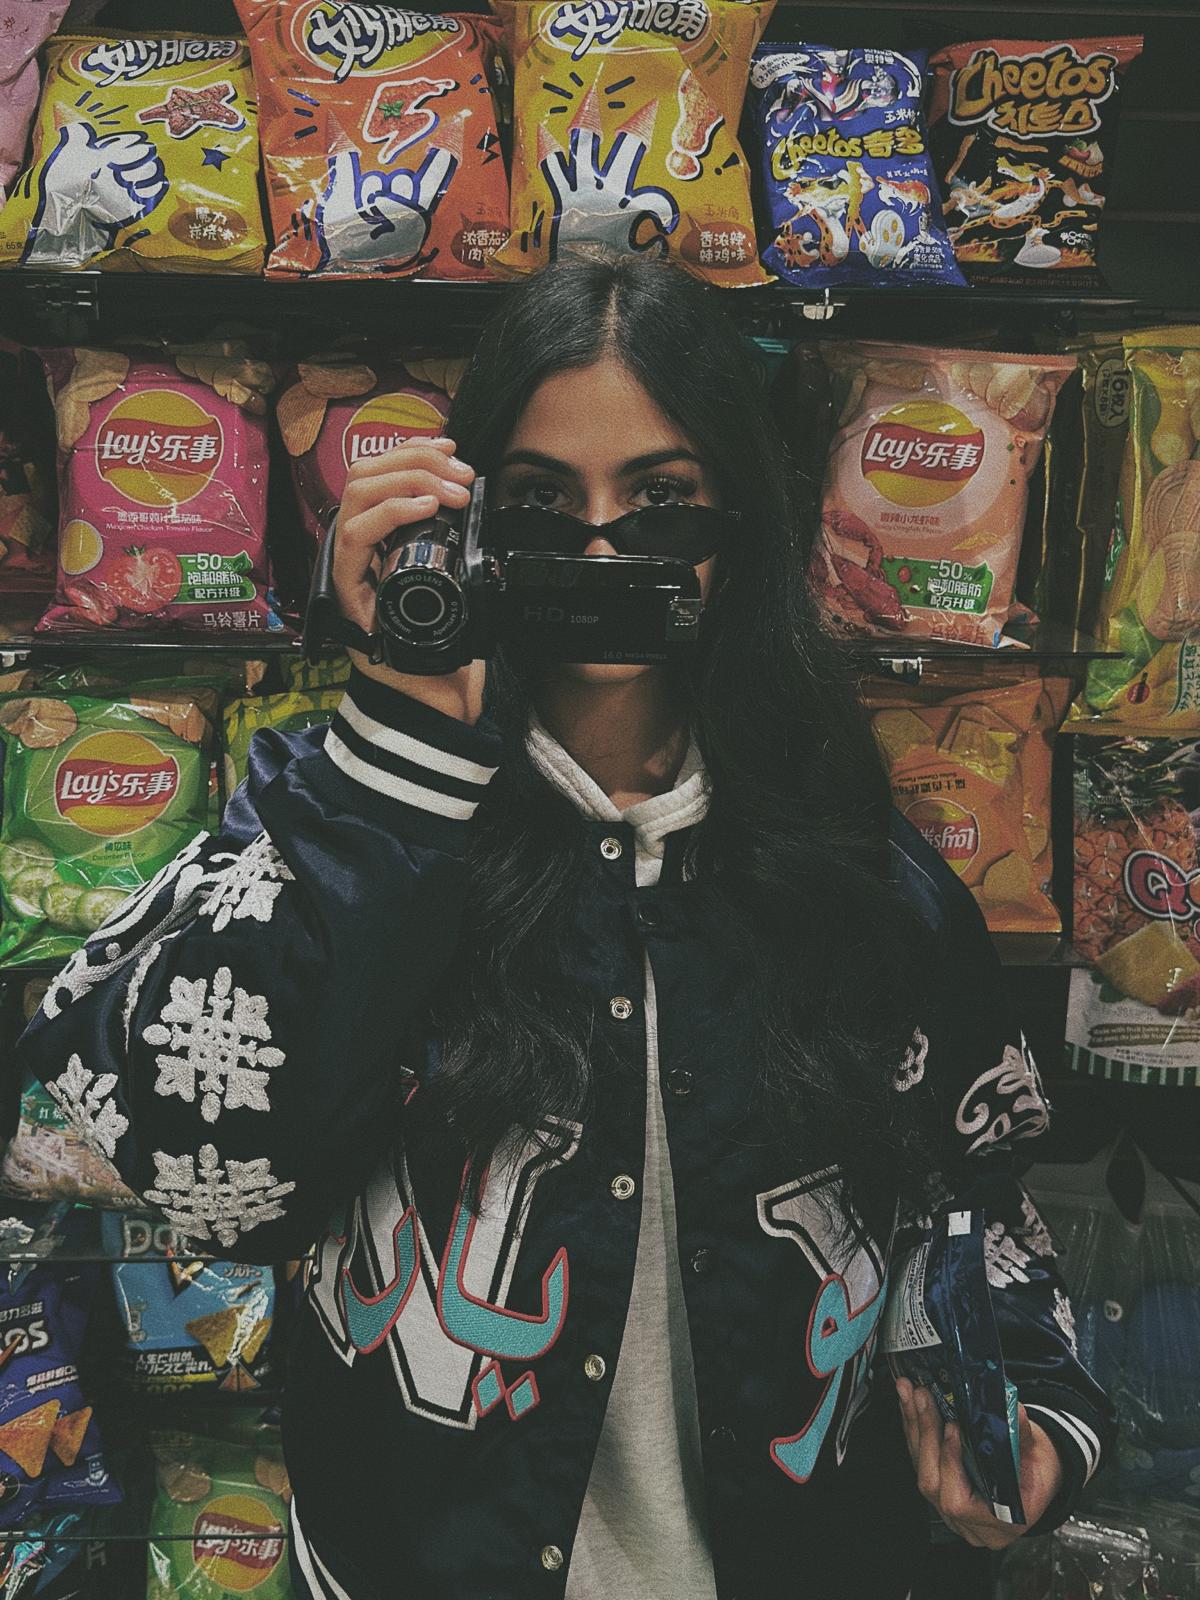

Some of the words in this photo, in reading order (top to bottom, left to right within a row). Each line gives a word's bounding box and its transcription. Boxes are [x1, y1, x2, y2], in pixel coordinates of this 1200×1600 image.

[954, 51, 1112, 117] Cheetos
[994, 98, 1096, 134] 치토스
[771, 127, 862, 180] Cheetos
[101, 430, 161, 464] Lay's
[160, 434, 218, 462] 乐事
[865, 432, 925, 469] Lay's
[920, 442, 981, 470] 乐事
[202, 610, 261, 628] 马铃薯片
[570, 615, 599, 624] 1080P
[61, 769, 120, 803] Lay's
[118, 771, 175, 799] 乐事
